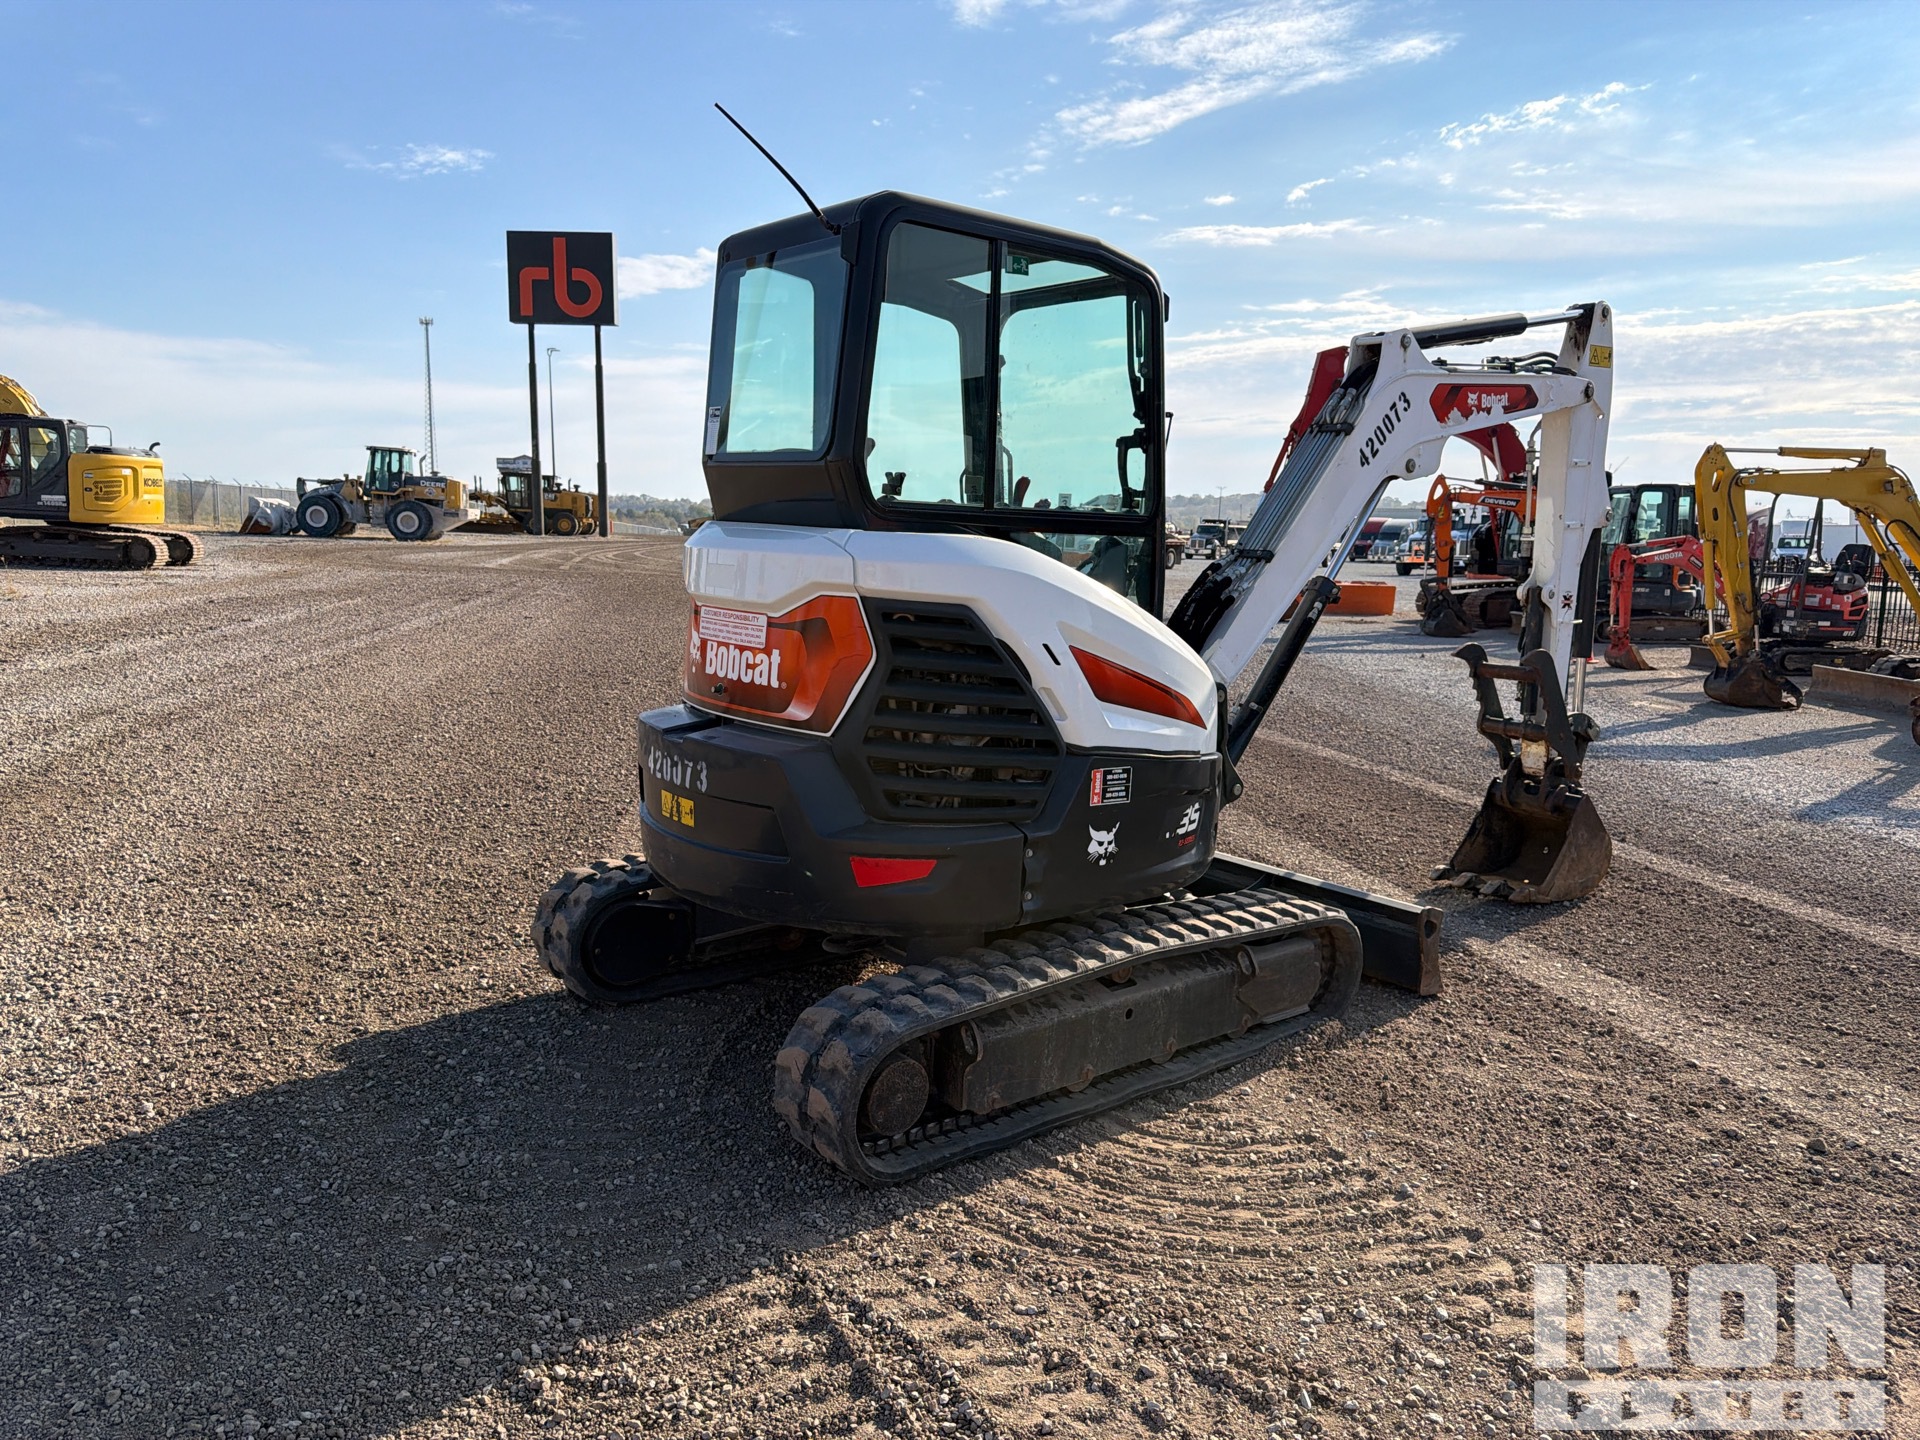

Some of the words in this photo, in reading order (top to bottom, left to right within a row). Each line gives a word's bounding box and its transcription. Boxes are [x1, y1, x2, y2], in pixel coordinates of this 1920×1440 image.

[519, 237, 603, 318] rb
[1358, 391, 1412, 469] 420073
[420, 480, 446, 488] DEERE
[1484, 497, 1517, 506] DEVELON
[1654, 551, 1684, 561] KUBOTA
[703, 608, 721, 616] CUSTOMER
[722, 611, 759, 622] RESPONSIBILITY
[705, 640, 781, 689] Bobcat
[648, 745, 708, 793] 420073
